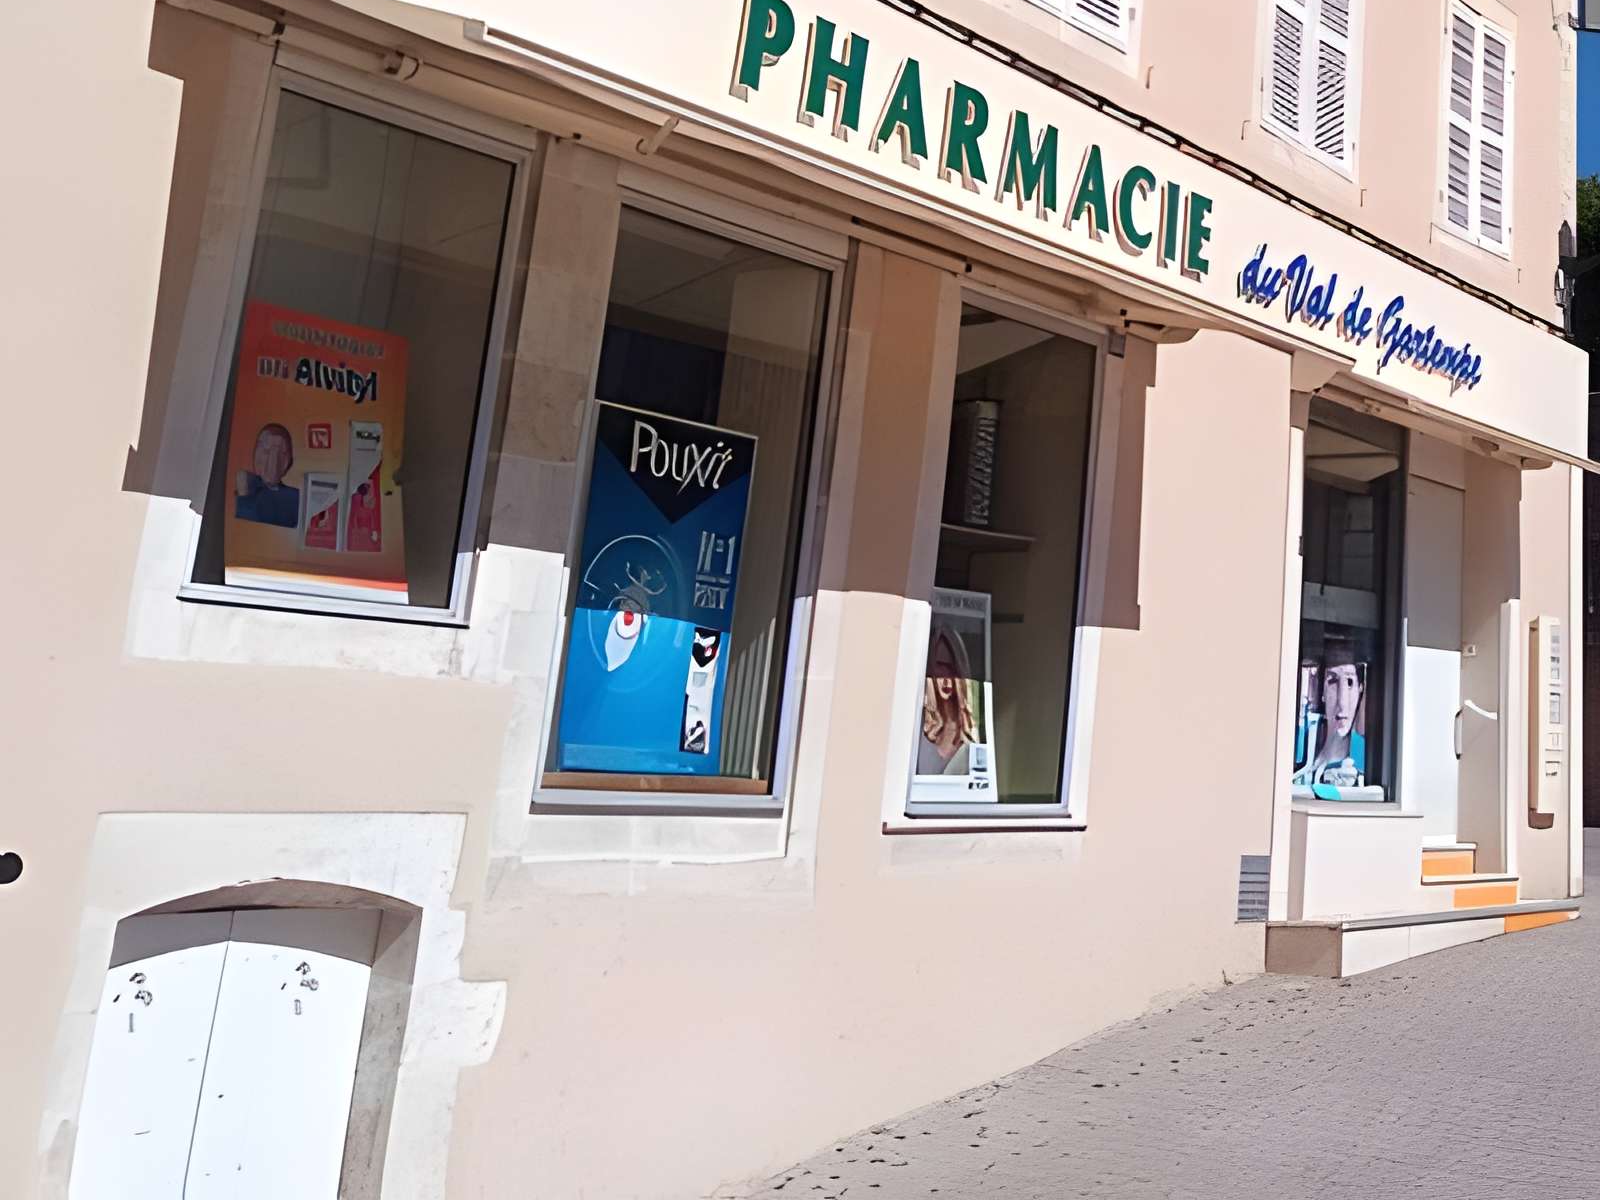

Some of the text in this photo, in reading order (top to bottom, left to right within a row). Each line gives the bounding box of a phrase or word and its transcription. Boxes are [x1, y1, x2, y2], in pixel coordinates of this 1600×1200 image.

[1242, 243, 1284, 308] du
[1285, 254, 1338, 330] Val
[1342, 286, 1373, 346] de
